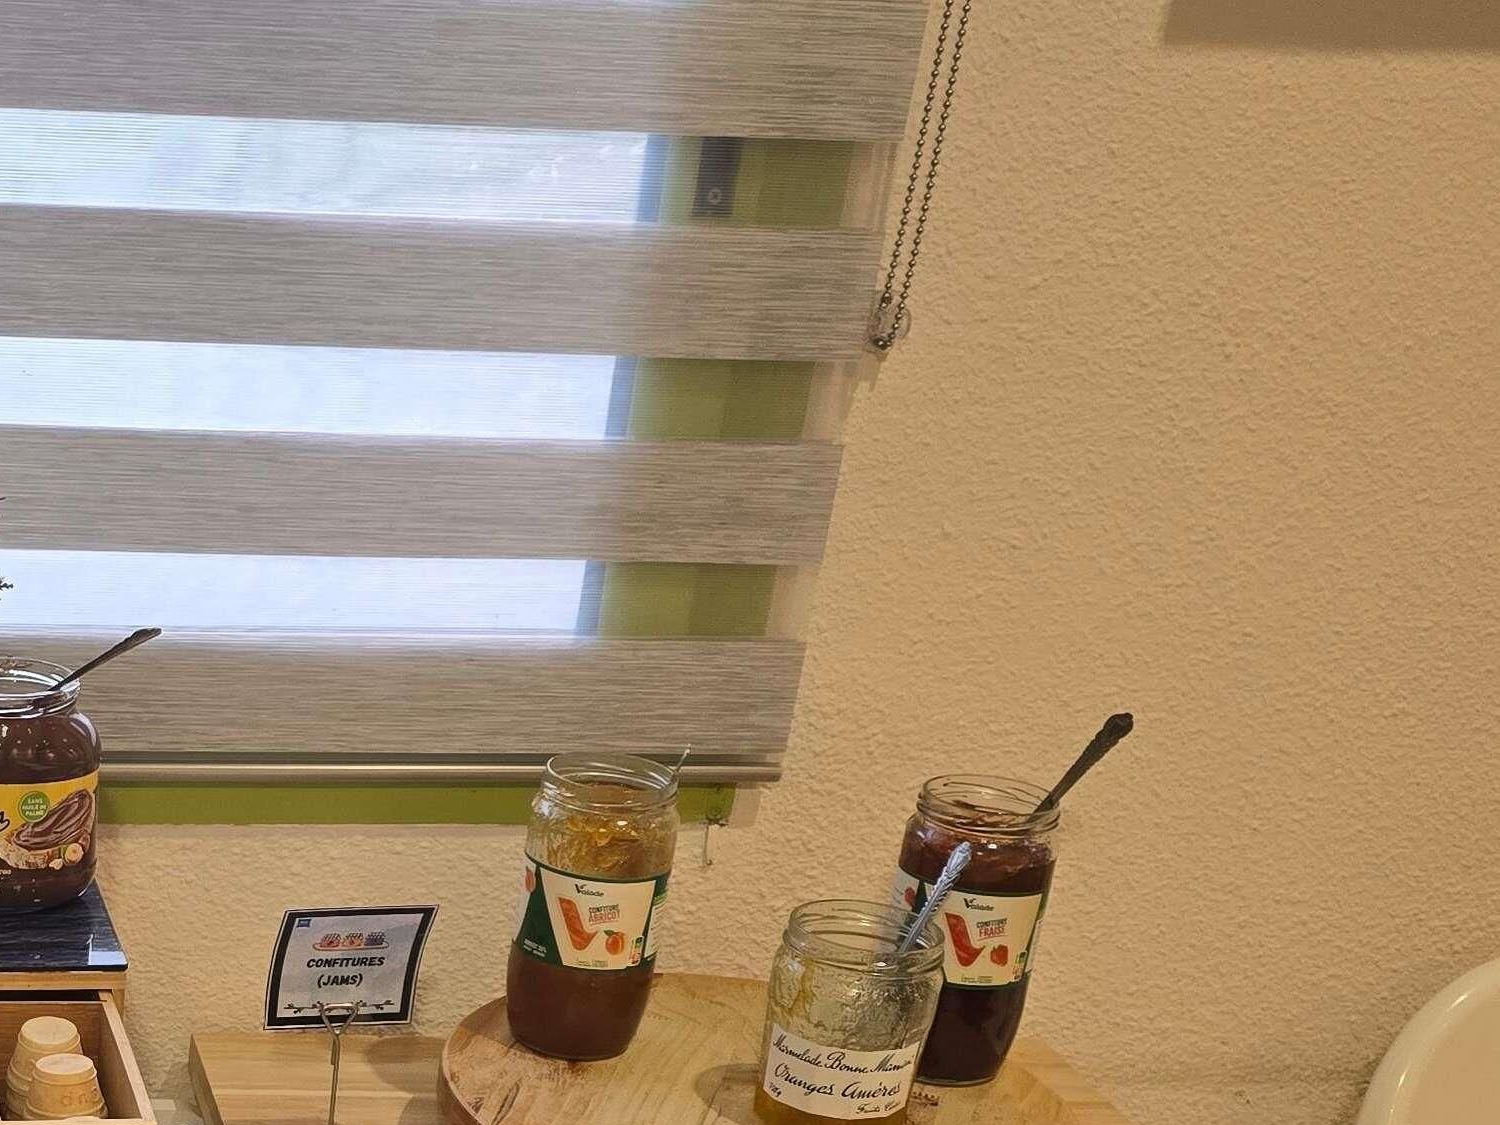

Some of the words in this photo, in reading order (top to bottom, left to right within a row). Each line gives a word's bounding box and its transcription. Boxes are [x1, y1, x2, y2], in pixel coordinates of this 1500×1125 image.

[306, 956, 385, 969] CONFITURES
[317, 973, 363, 989] (JAMS)
[824, 1051, 869, 1074] Bonne
[774, 1062, 835, 1097] Oranges
